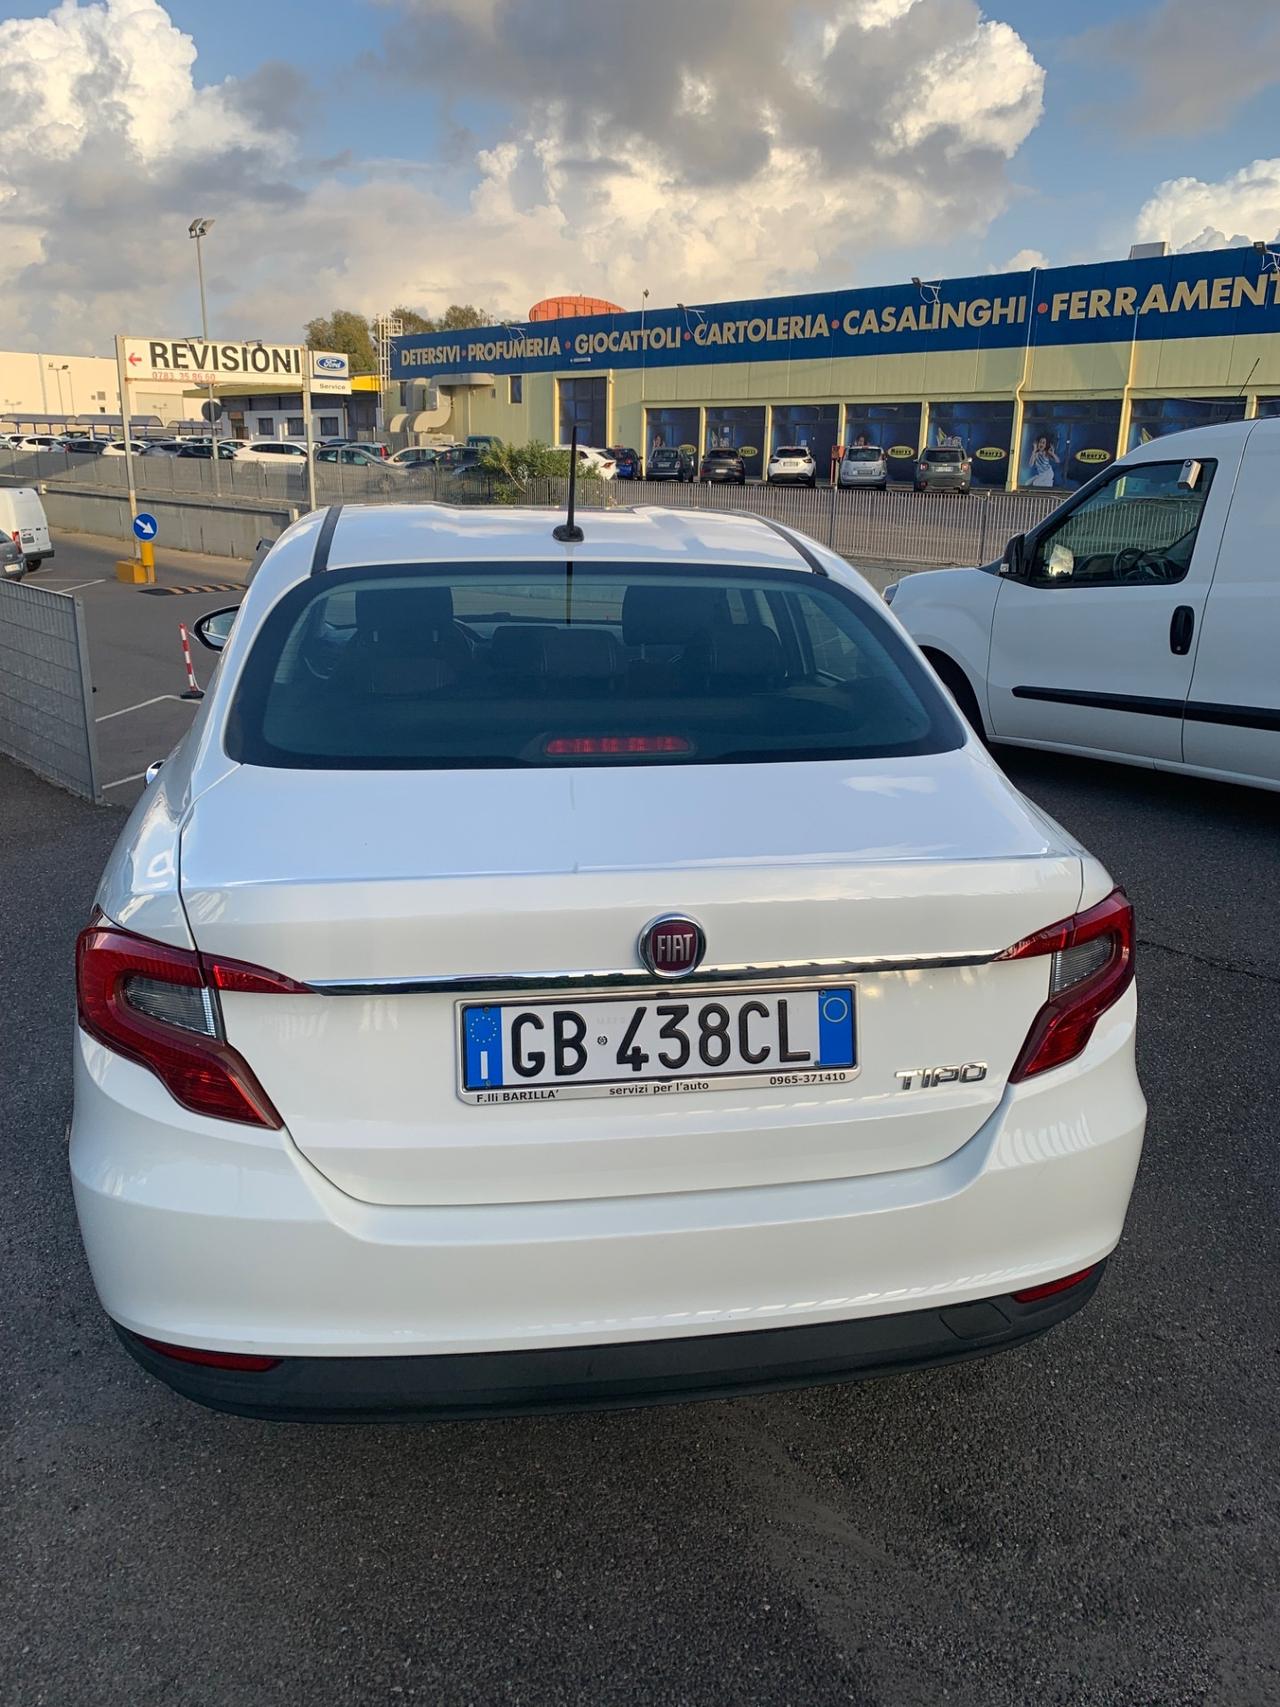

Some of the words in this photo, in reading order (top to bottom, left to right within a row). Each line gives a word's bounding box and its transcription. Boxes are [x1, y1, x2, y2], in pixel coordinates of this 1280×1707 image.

[401, 346, 461, 367] DETERSIVI
[467, 336, 561, 362] PROFUMERIA
[574, 327, 681, 354] GIOCATTOLI
[693, 313, 830, 345] CARTOLERIA
[842, 296, 1027, 335] CASALINGHI
[150, 342, 300, 374] REVISIONI
[657, 934, 693, 962] FIAT
[511, 1010, 588, 1078] GB
[616, 999, 811, 1072] 438CL
[480, 1051, 489, 1080] I
[769, 1072, 846, 1086] 0965-371410
[894, 1061, 988, 1091] TIPO
[609, 1085, 649, 1096] servizi
[653, 1084, 672, 1094] per
[676, 1081, 709, 1092] l'auto
